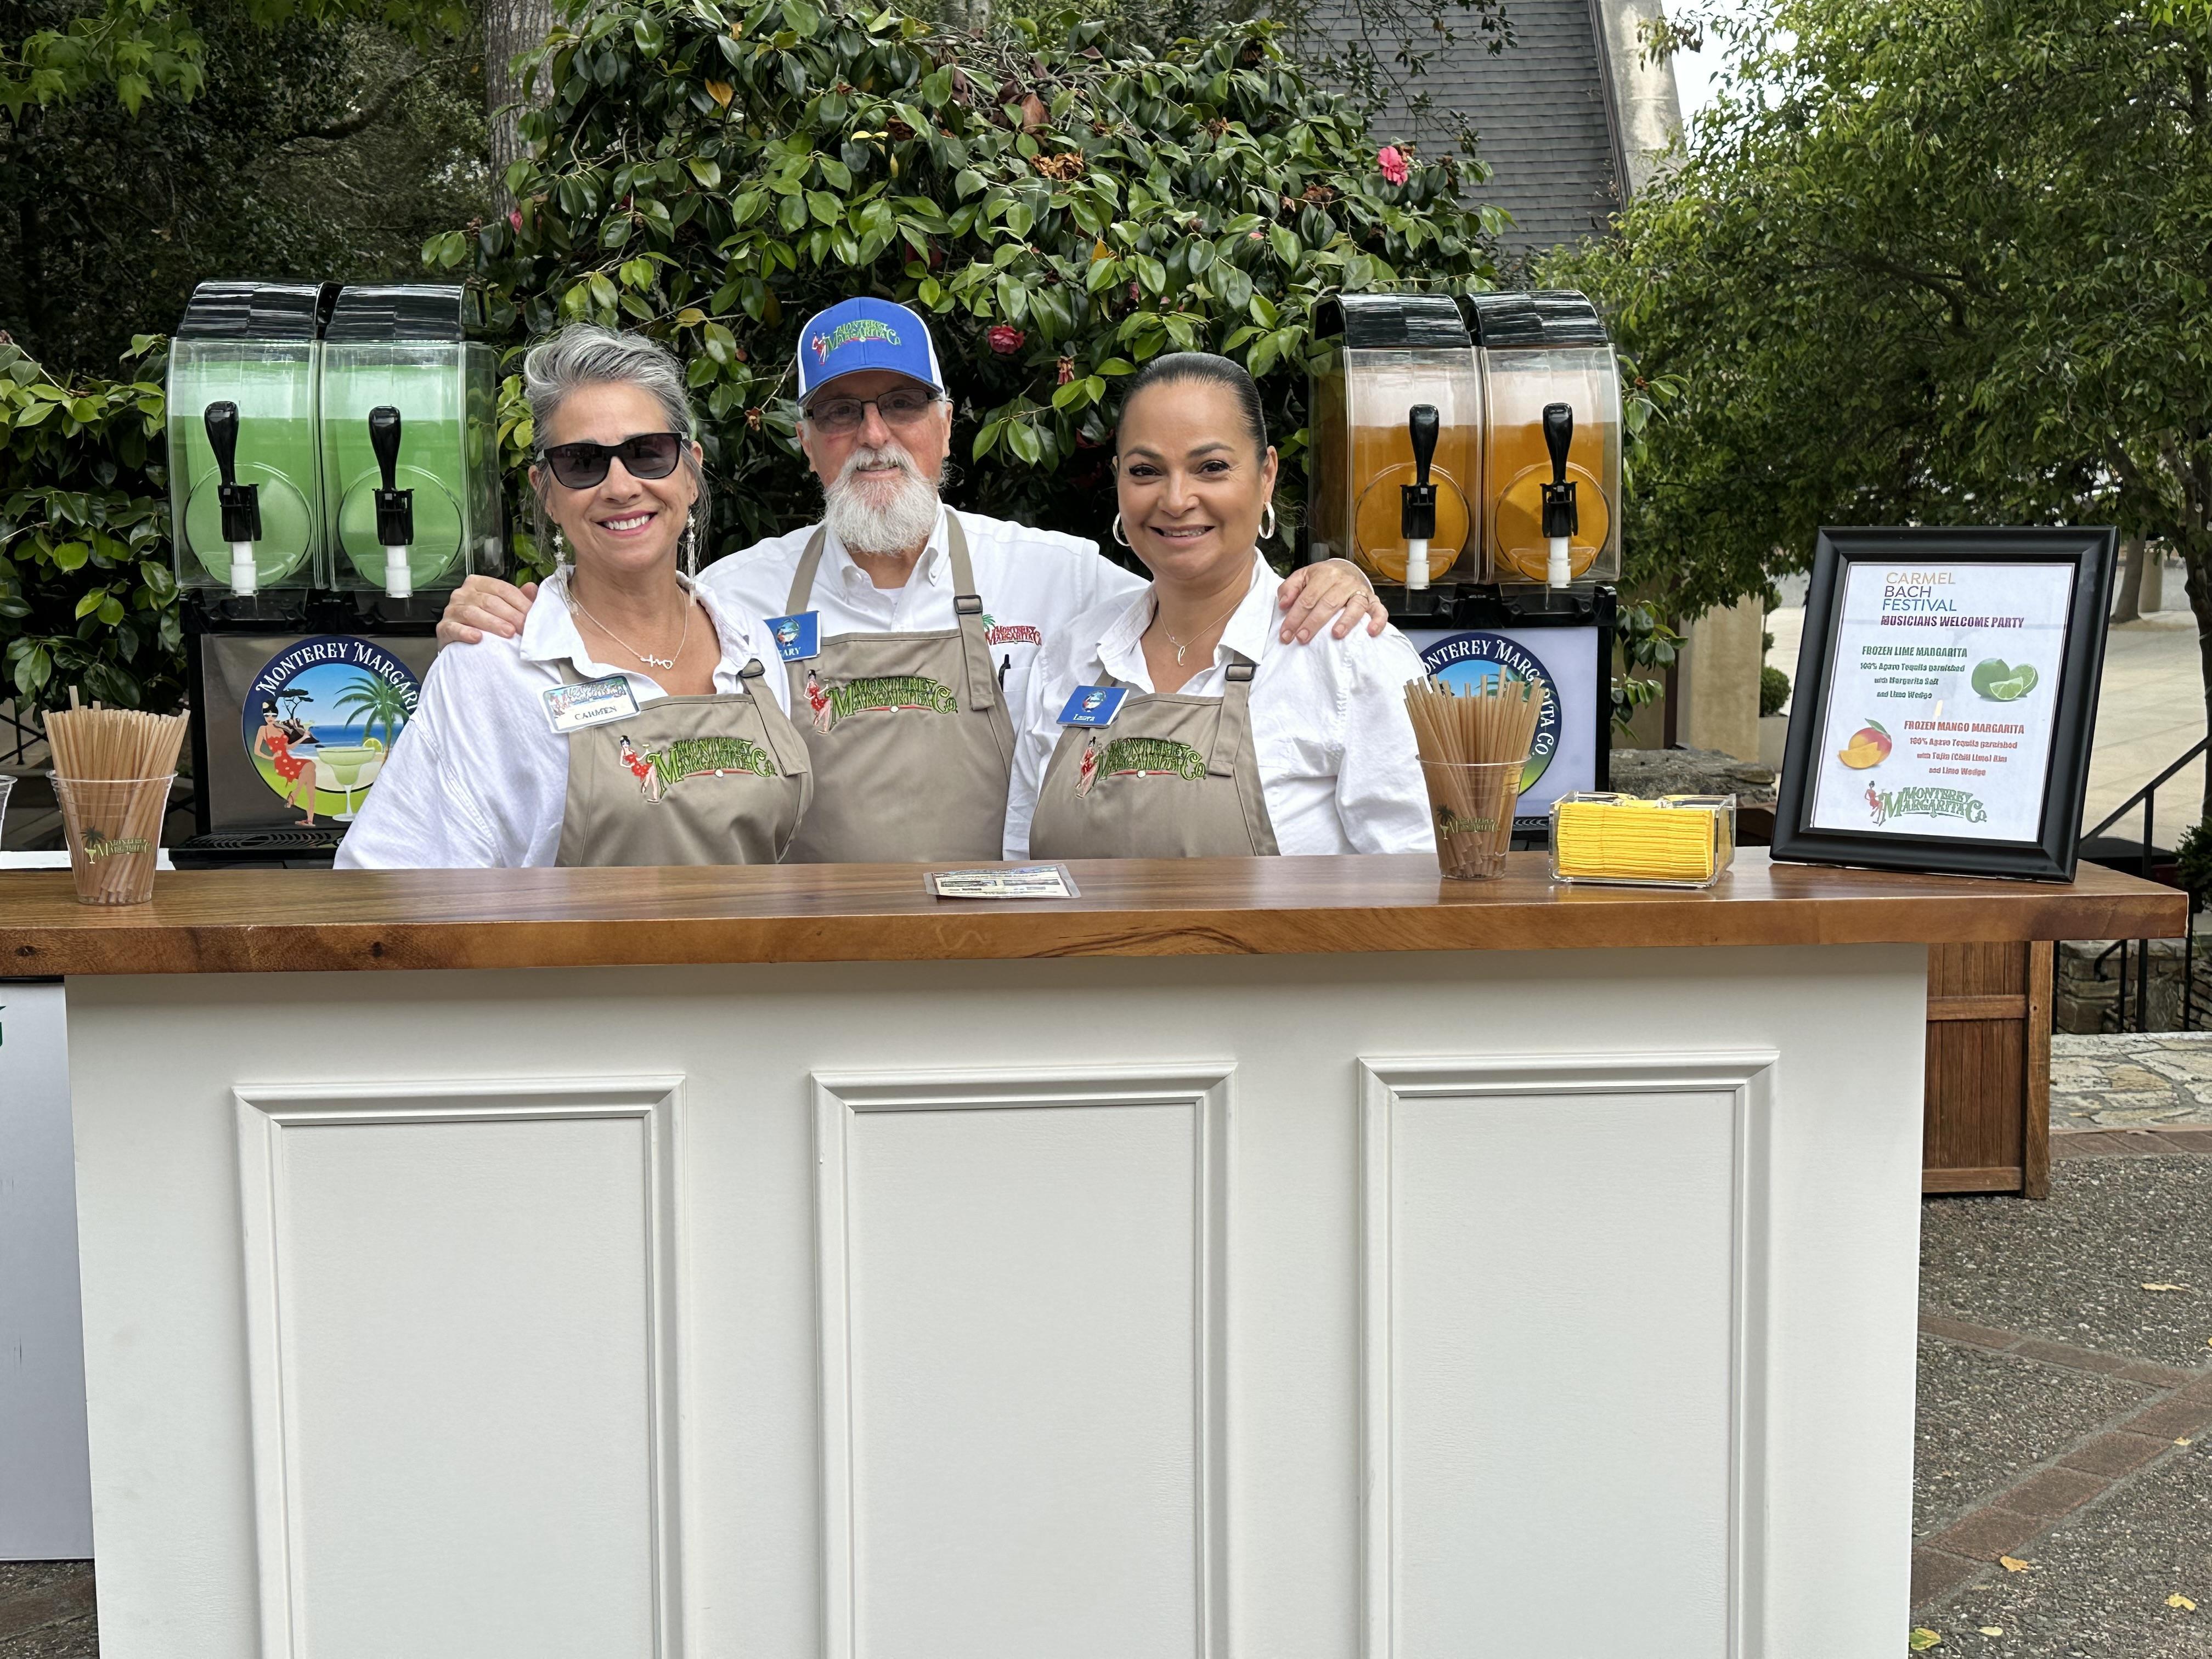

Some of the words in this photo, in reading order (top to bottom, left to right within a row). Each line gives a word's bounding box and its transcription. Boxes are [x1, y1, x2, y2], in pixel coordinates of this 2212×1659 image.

[1887, 572, 1956, 585] CARMEL
[1884, 586, 1931, 597] BACH
[1882, 599, 1957, 611] FESTIVAL
[1881, 616, 1937, 626] MUSICIANS
[1940, 616, 1990, 628] WELCOME
[1991, 617, 2024, 628] PARTY
[780, 647, 801, 657] ARY
[1425, 640, 1491, 675] ONTEREY
[1862, 646, 1893, 656] FROZEN
[1894, 646, 1915, 656] LIME
[1916, 647, 1967, 657] MARGARITA
[256, 642, 348, 696] MONTEREY
[852, 676, 938, 695] MONTEREY
[1889, 676, 1923, 685] Margarita
[1908, 691, 1932, 699] Wedge
[575, 706, 618, 720] CARMEN
[825, 684, 933, 731] MARGARITA
[1904, 720, 1936, 730] FROZEN
[1937, 721, 1970, 732] MANGO
[1971, 723, 2024, 734] MARGARITA
[1952, 739, 1978, 747] Tequila
[1961, 768, 1986, 776] Wedge
[1903, 787, 1973, 803] MONTEREY
[1876, 792, 1965, 825] MARGARITA
